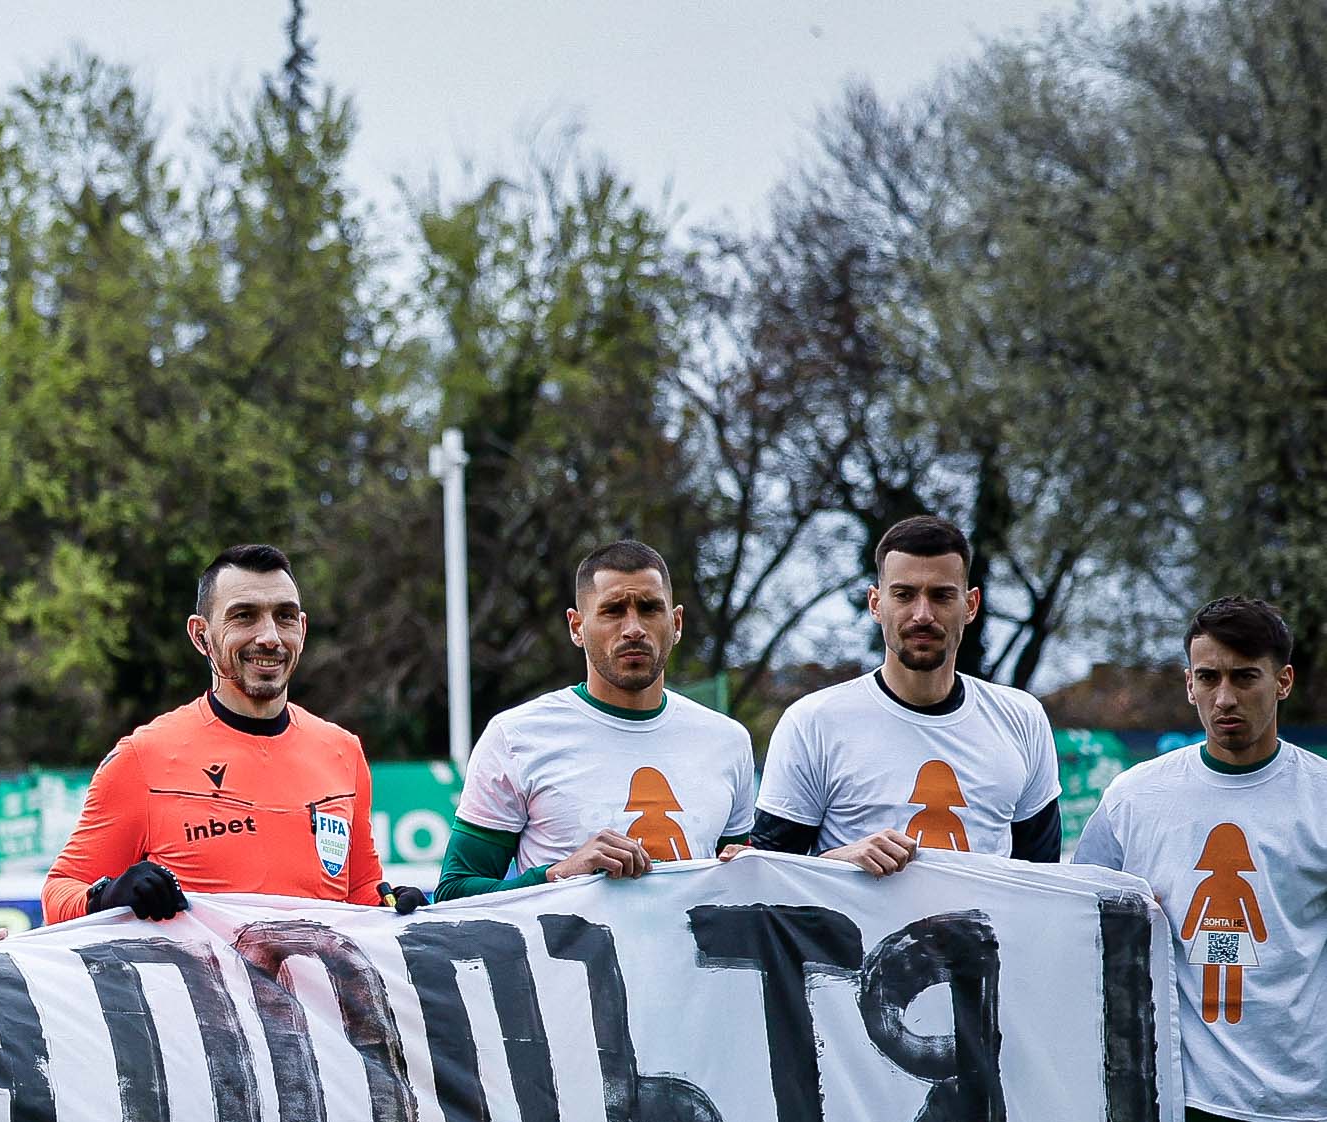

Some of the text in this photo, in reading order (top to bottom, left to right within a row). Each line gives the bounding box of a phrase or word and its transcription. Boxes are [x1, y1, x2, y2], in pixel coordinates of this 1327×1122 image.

[184, 816, 257, 842] inbet
[320, 817, 346, 837] FIFA
[1203, 917, 1230, 927] ЗОНТА
